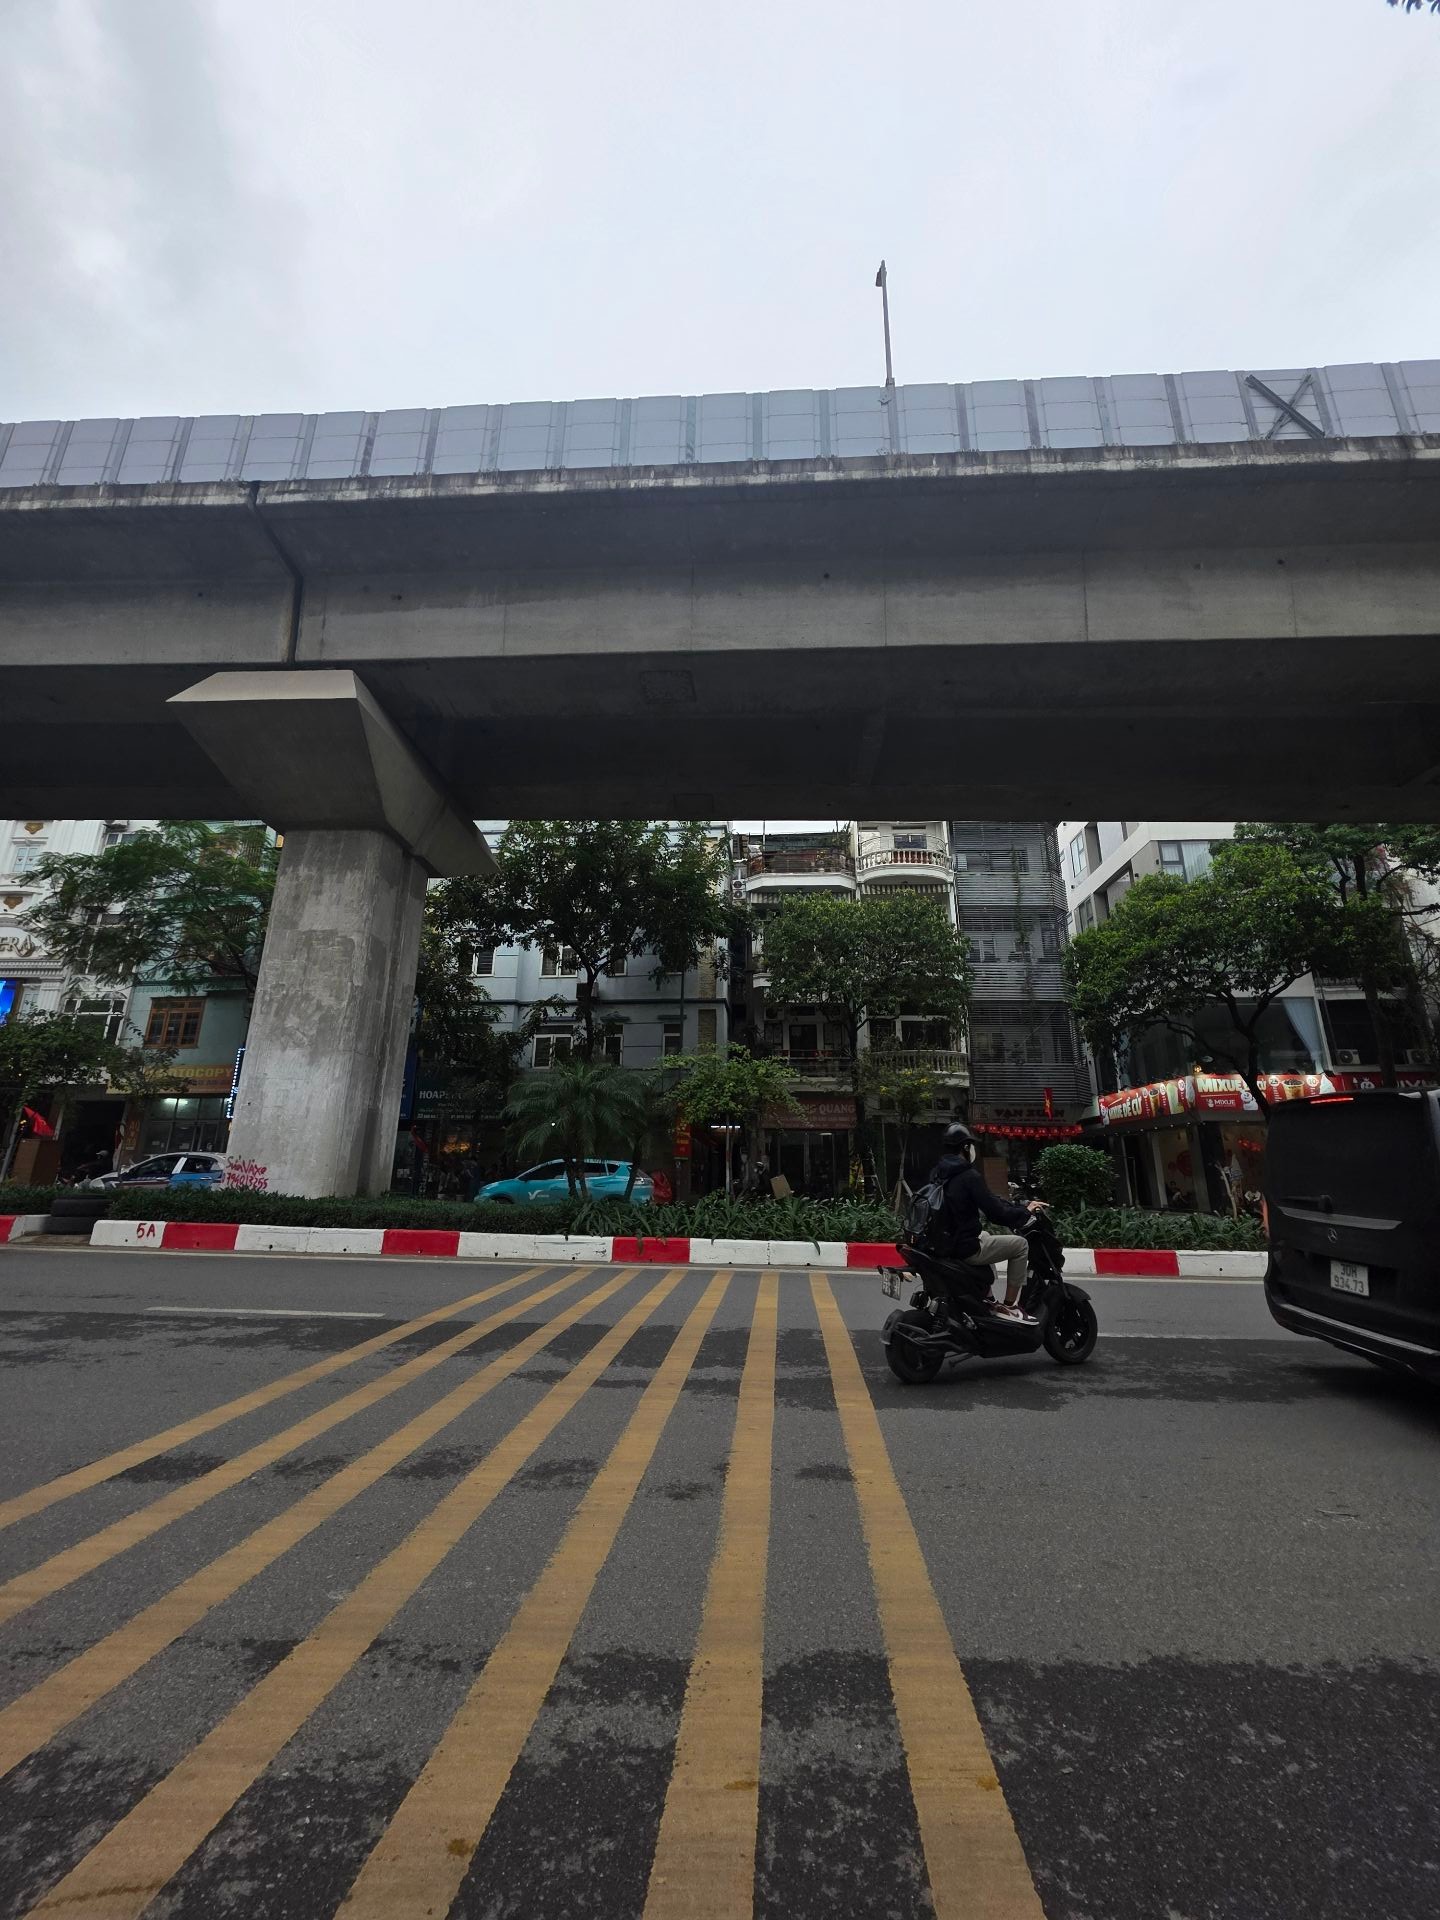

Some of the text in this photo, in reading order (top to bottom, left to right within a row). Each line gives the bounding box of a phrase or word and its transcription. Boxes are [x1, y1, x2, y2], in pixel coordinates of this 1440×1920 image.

[1197, 1078, 1241, 1092] MIXUE
[818, 1104, 856, 1115] QUANG
[136, 1222, 156, 1239] 5A
